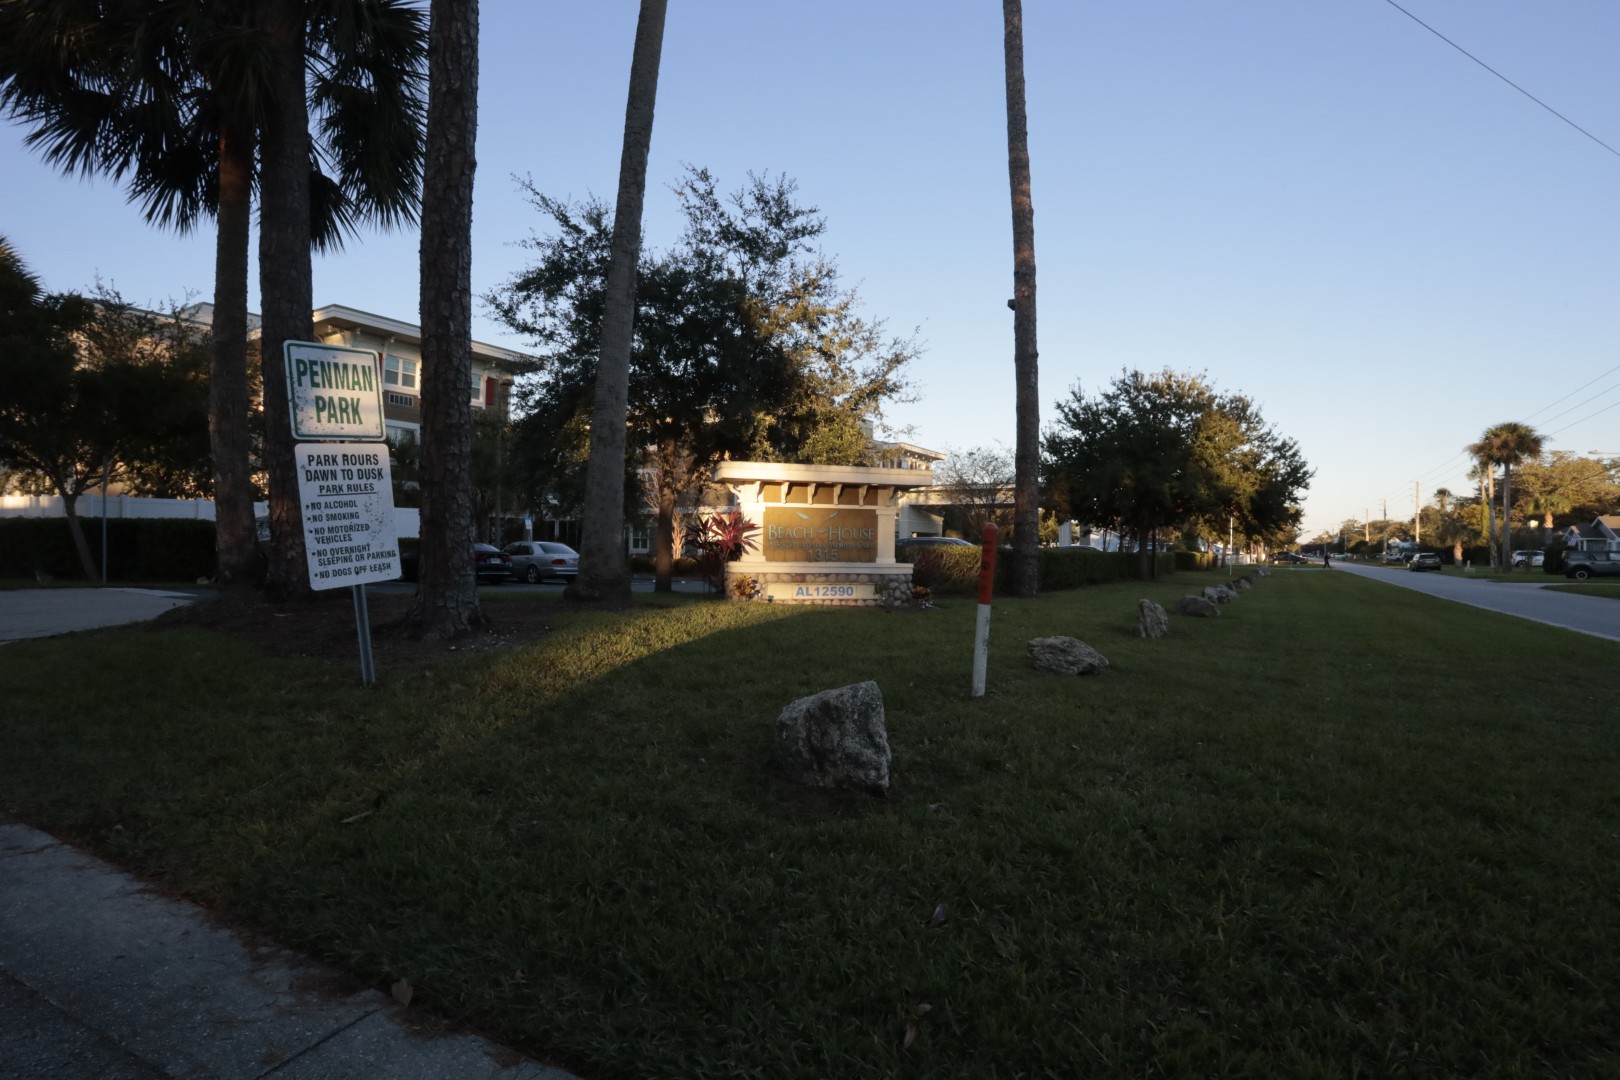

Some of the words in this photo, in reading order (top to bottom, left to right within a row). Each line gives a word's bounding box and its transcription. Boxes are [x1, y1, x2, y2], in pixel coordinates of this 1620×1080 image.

[296, 359, 374, 392] PENMAN
[315, 395, 363, 424] PARK
[308, 454, 338, 466] PARK
[342, 454, 379, 466] HOURS
[306, 470, 337, 482] DAWN
[341, 469, 353, 480] TO
[357, 468, 384, 480] DUSK
[319, 484, 344, 493] PARK
[347, 483, 374, 492] RULES
[310, 502, 321, 510] NO
[324, 500, 358, 509] ALCOHOL
[326, 512, 359, 520] SMOKING
[314, 527, 325, 535] NO
[328, 524, 370, 533] MOTORIZED
[316, 534, 352, 544] VEHICLES
[317, 549, 327, 557] NO
[330, 544, 370, 554] OVERNIGHT
[808, 549, 838, 560] 1315
[318, 556, 353, 566] SLEEPING
[367, 550, 396, 560] PARKING
[320, 570, 330, 579] NO
[332, 568, 352, 577] DOGS
[370, 562, 392, 572] LEASH
[796, 586, 854, 597] AL12590
